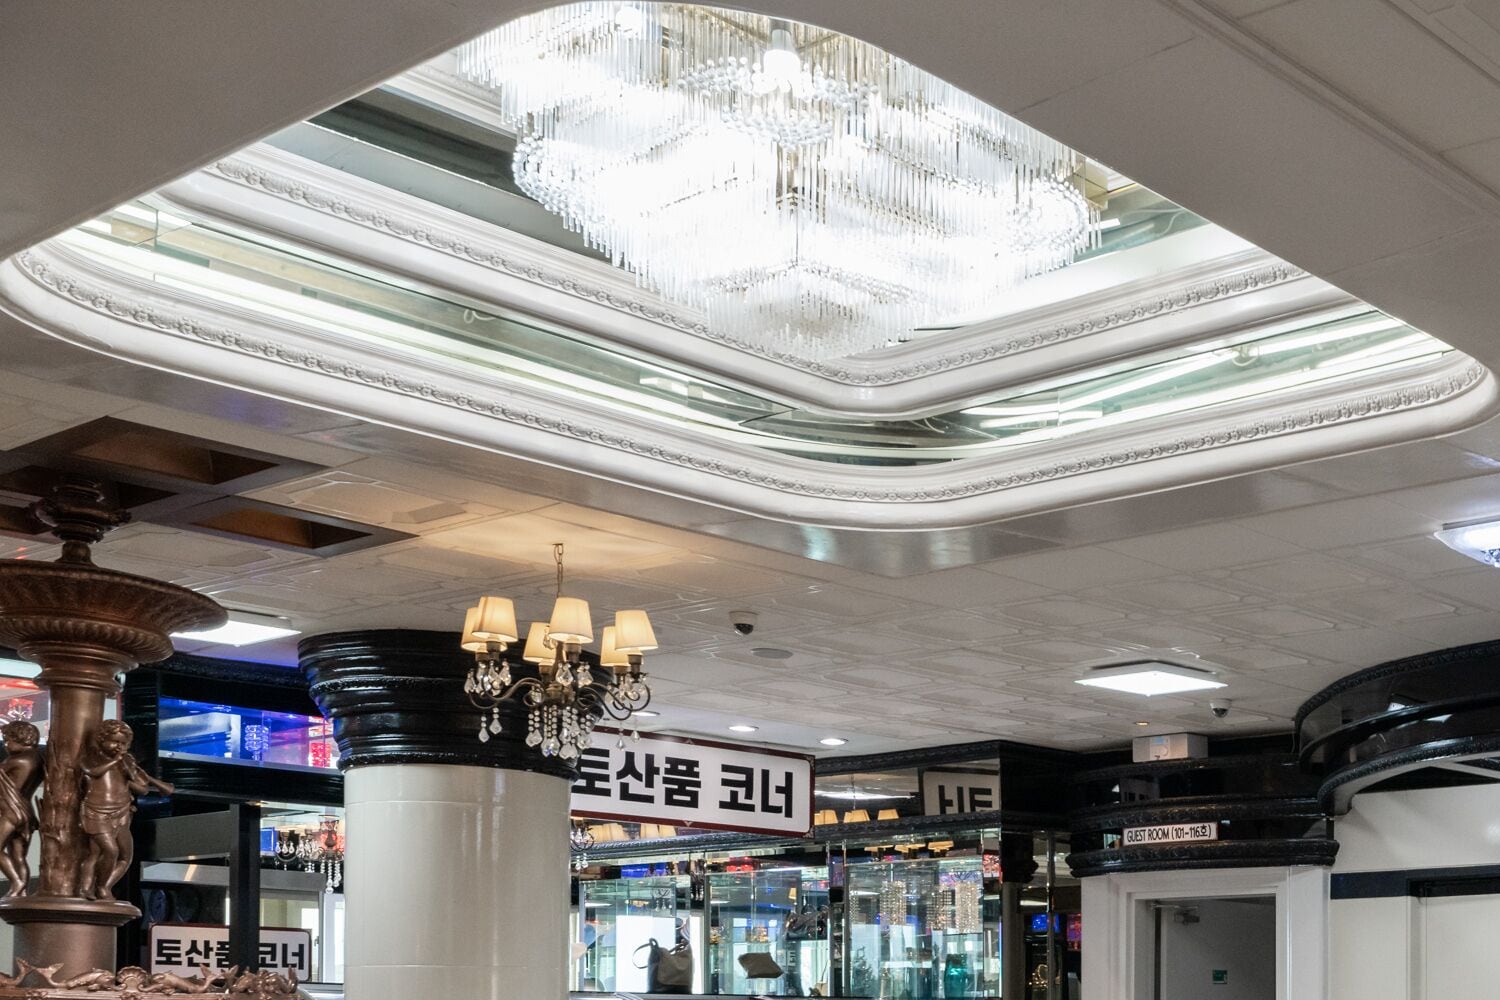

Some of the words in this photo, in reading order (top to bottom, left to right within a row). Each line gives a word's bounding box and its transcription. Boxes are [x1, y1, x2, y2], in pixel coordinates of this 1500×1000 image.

[571, 747, 701, 808] 토산품
[719, 764, 793, 818] 코너
[1127, 829, 1146, 842] GUEST
[1148, 827, 1169, 840] ROOM
